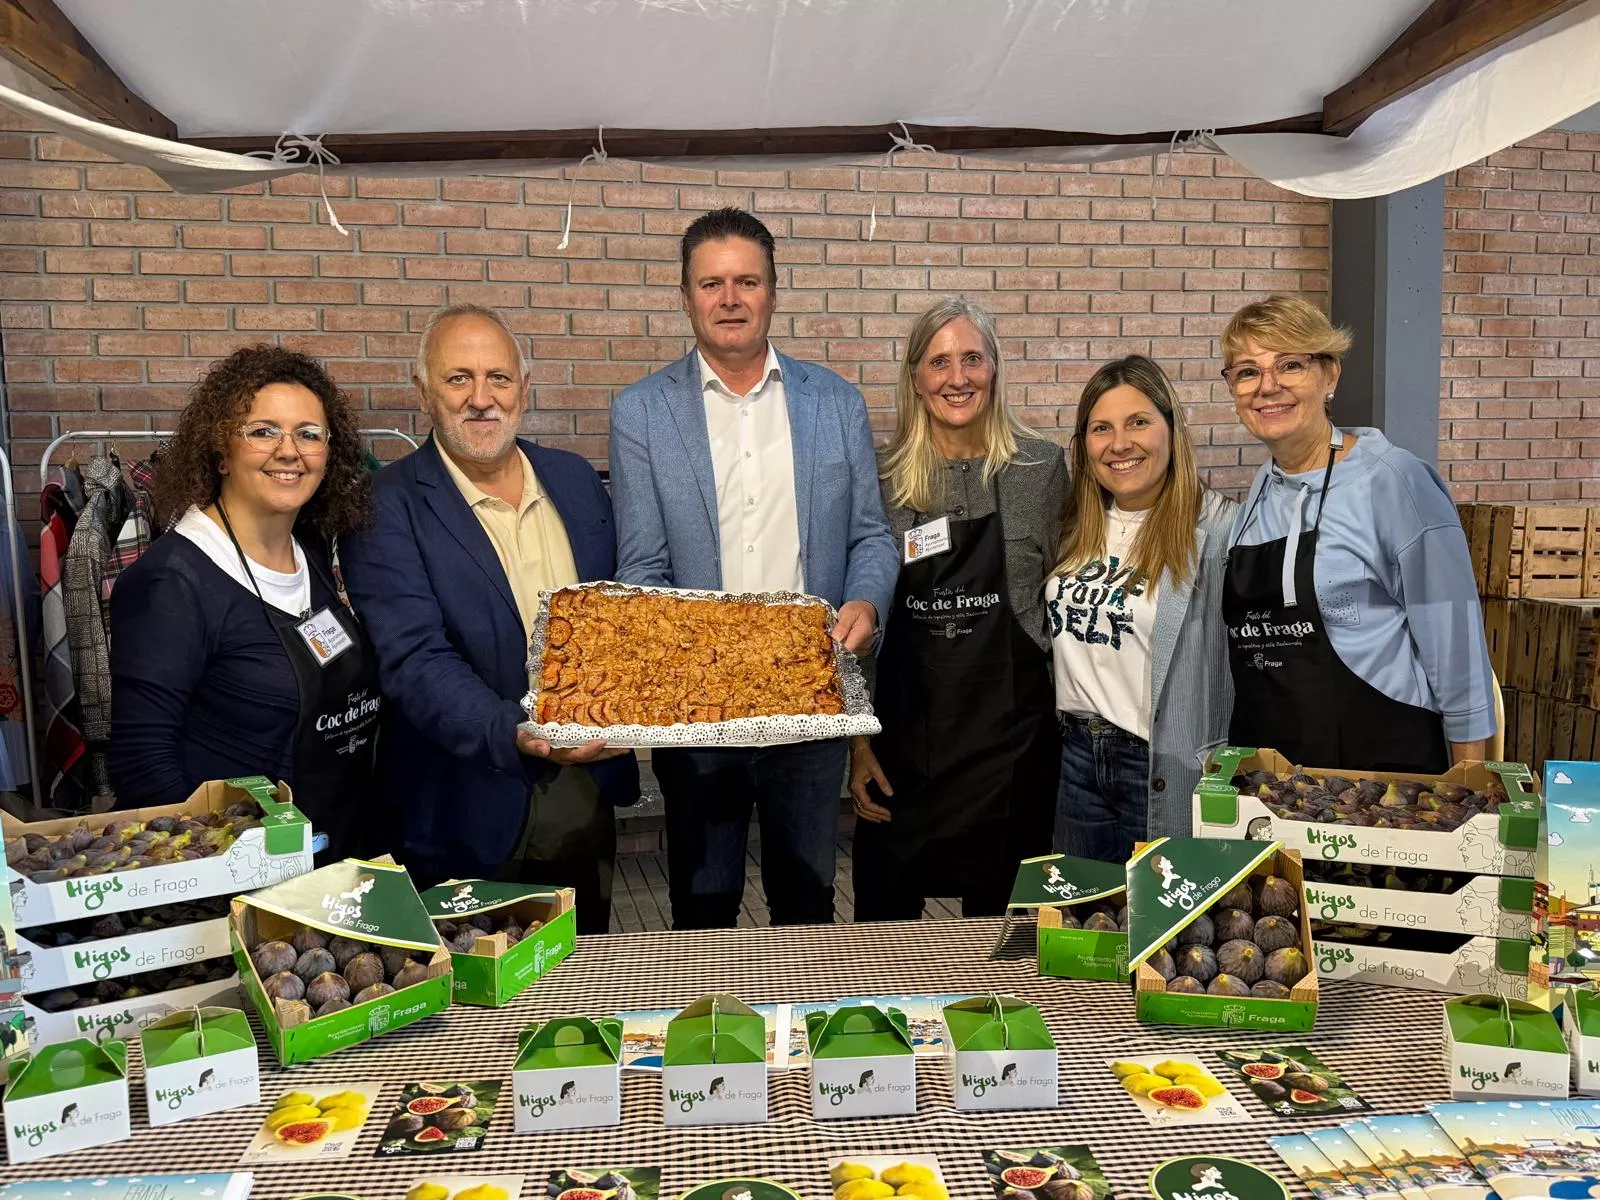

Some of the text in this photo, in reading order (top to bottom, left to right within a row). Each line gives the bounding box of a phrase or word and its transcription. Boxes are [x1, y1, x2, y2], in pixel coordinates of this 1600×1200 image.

[924, 532, 941, 541] Fraga
[906, 593, 1001, 611] Coc de Fraga
[321, 626, 336, 637] Fraga
[1240, 622, 1261, 638] de
[1262, 621, 1315, 638] Fraga
[1264, 660, 1283, 668] Fraga
[315, 714, 342, 731] Coc
[344, 707, 359, 723] de
[360, 696, 381, 717] Frag
[1306, 827, 1428, 865] Higos de Fraga
[66, 876, 199, 910] Higos de Fraga
[1042, 882, 1078, 900] Higos
[1157, 878, 1197, 911] Higos
[1192, 876, 1221, 901] de Fraga
[321, 895, 362, 924] Higos
[440, 897, 480, 913] Higos
[1305, 887, 1427, 927] Higos de Fraga
[343, 917, 380, 933] de Fraga
[74, 945, 206, 980] Higos de Fraga
[545, 942, 562, 960] Fraga
[1357, 957, 1377, 972] de
[1382, 961, 1425, 980] Fraga
[392, 1001, 427, 1020] Fraga
[1248, 1014, 1286, 1024] Fraga
[77, 1009, 134, 1043] Higos
[962, 1074, 1053, 1098] Higos de Fraga
[1459, 1064, 1563, 1091] Higos de Fraga
[155, 1074, 254, 1110] Higos de Fraga
[669, 1088, 762, 1113] Higos de Fraga
[819, 1082, 911, 1106] Higos de Fraga
[519, 1094, 614, 1118] Higos de Fraga
[14, 1109, 122, 1147] Higos de Fraga
